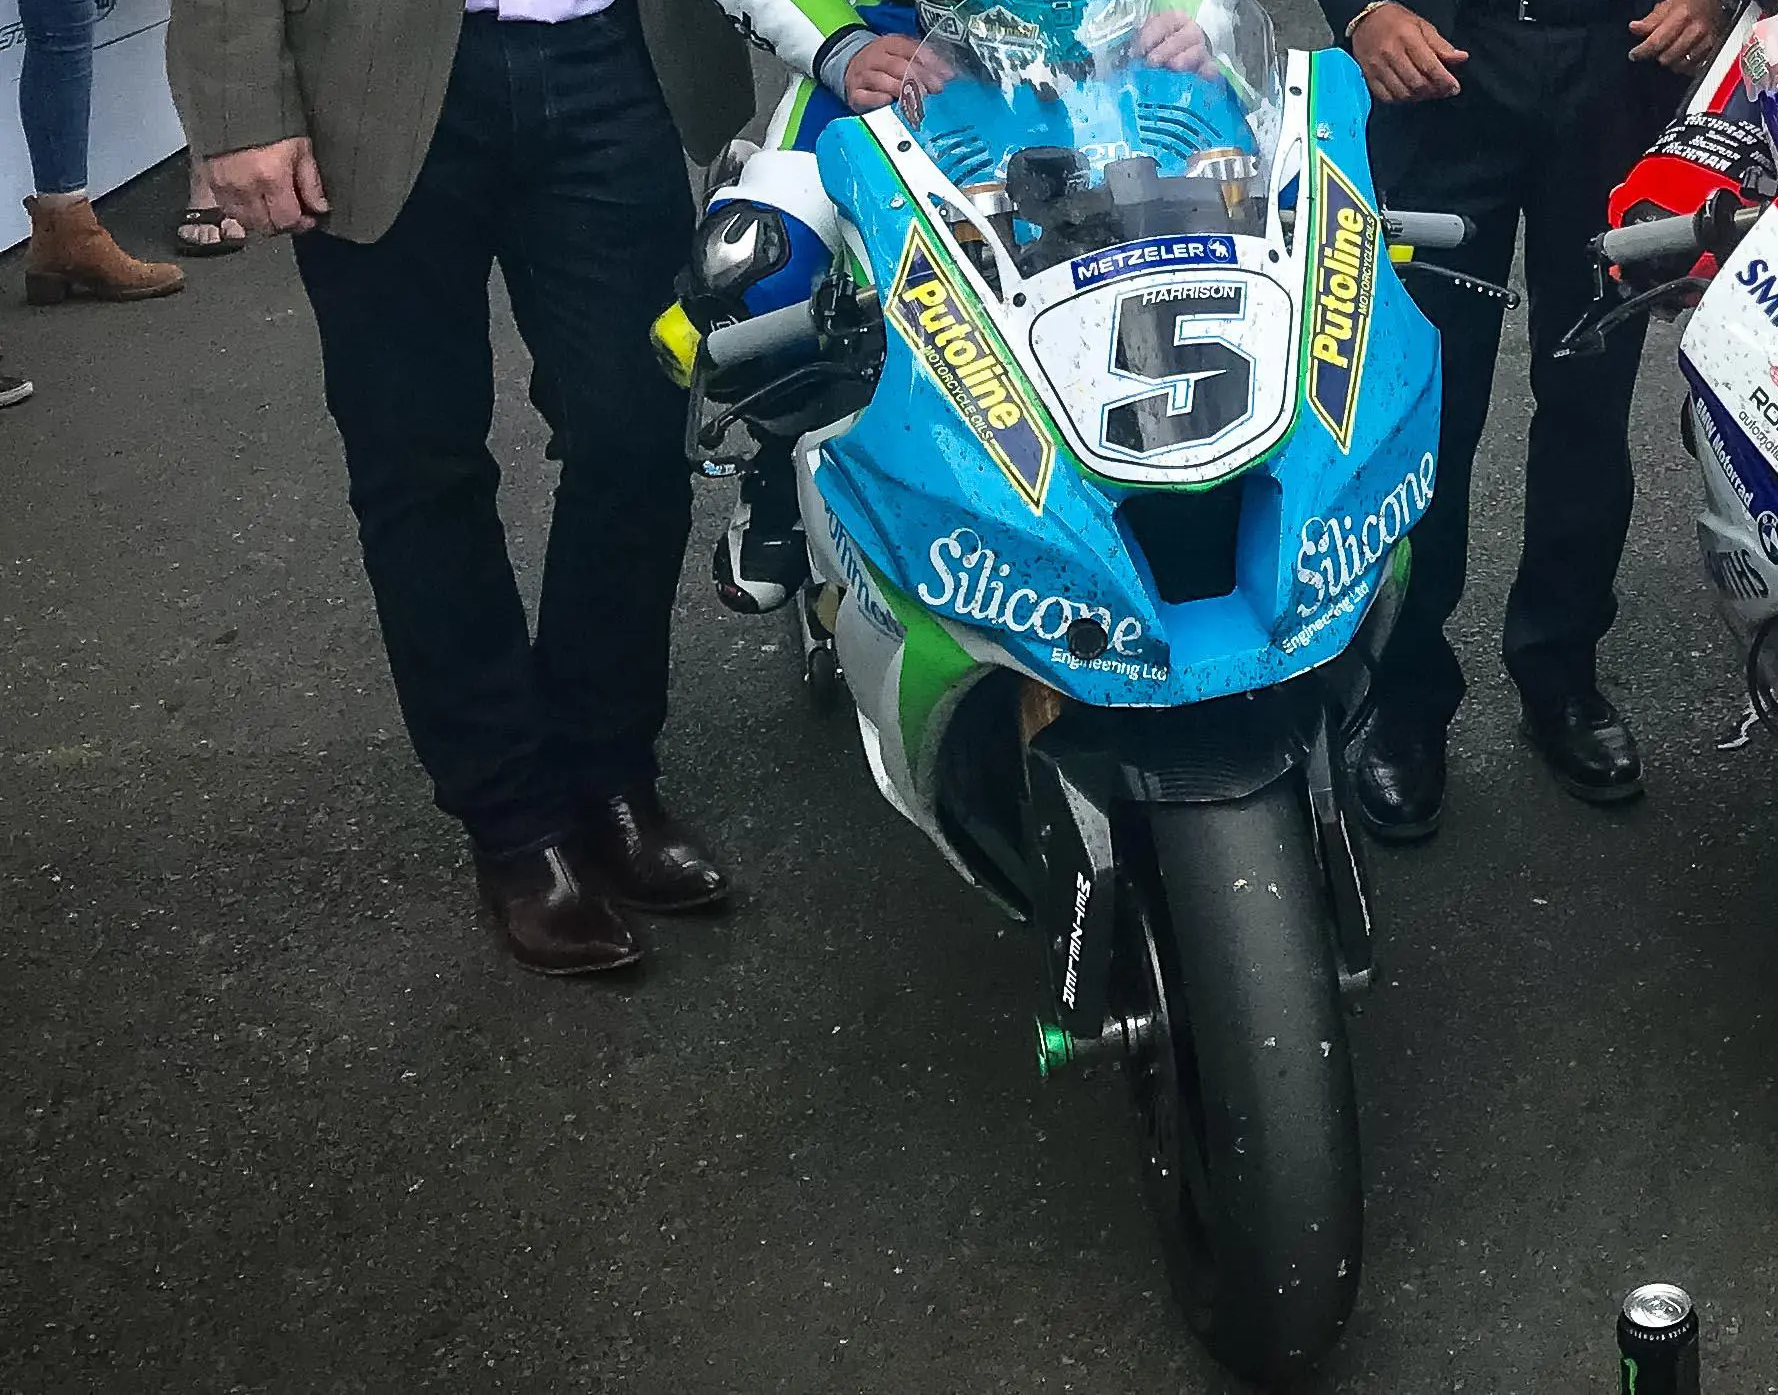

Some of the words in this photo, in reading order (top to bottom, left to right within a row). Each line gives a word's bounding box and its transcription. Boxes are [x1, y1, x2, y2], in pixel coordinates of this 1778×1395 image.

[1077, 243, 1204, 282] METZELER
[1366, 215, 1376, 239] OILS
[1142, 285, 1235, 306] HARRISON
[1313, 207, 1364, 369] Putoline
[1359, 239, 1373, 315] MOTORCYCLE
[902, 280, 1023, 430] Putoline
[924, 344, 976, 418] MOTORCYCLE
[970, 414, 994, 442] OILS
[1100, 281, 1257, 459] 5
[1712, 435, 1754, 507] Motorrad
[1296, 452, 1435, 618] Silicone
[1283, 597, 1355, 654] Engineering
[1350, 580, 1370, 604] Ltd
[1142, 664, 1168, 682] Ltd
[1062, 871, 1092, 1009] METZELER
